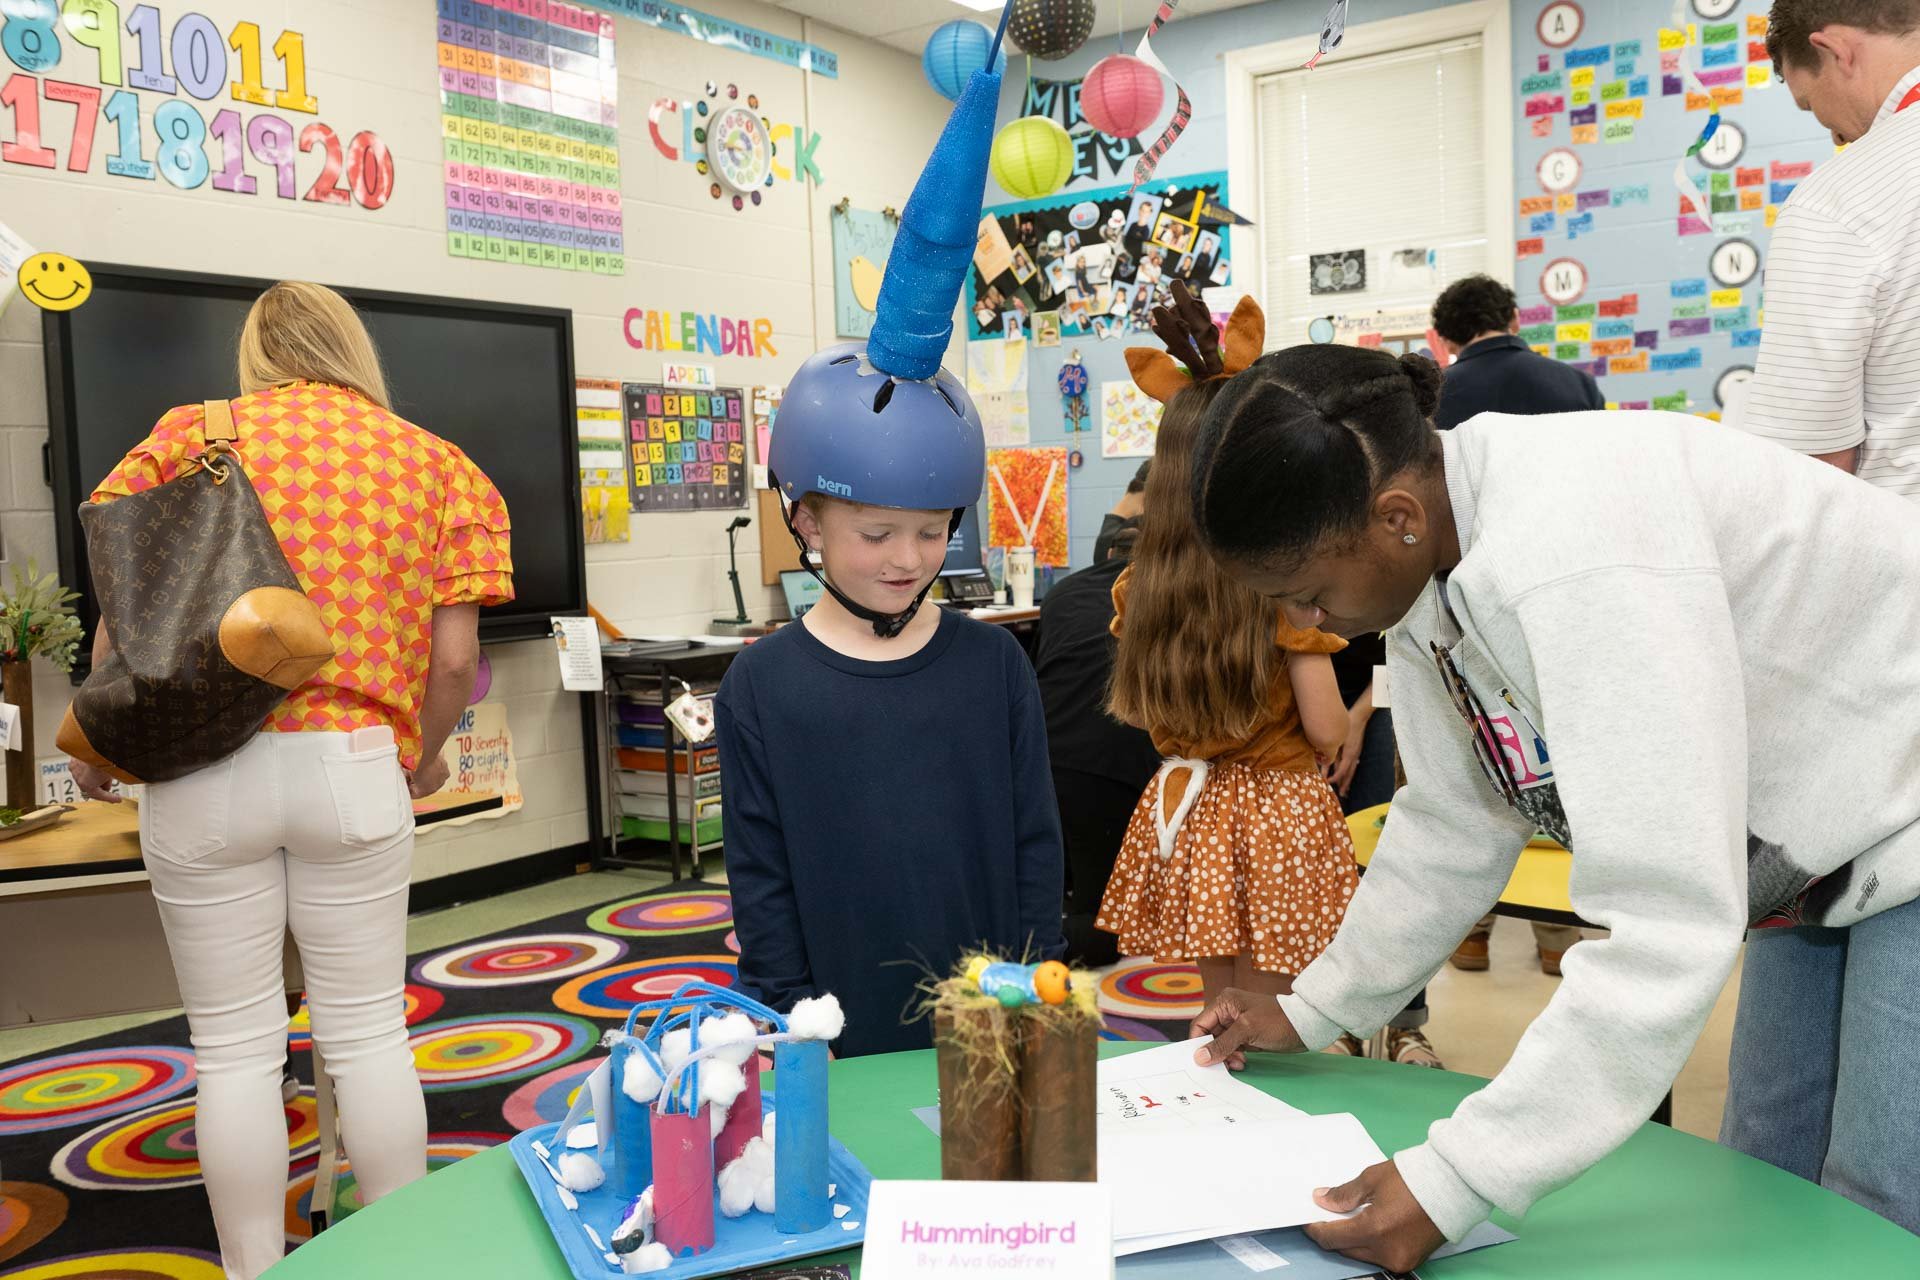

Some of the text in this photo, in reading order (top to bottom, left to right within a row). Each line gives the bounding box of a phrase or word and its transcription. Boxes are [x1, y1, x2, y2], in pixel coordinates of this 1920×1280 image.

[1554, 12, 1566, 34] A
[461, 28, 473, 42] 22
[480, 33, 491, 47] 23
[0, 0, 318, 115] 8 9 10 11
[444, 48, 453, 61] 31
[463, 52, 474, 66] 32
[480, 56, 493, 70] 33
[144, 74, 162, 87] ten
[462, 76, 476, 90] 42
[1521, 73, 1562, 93] about
[47, 85, 98, 100] seventeen
[1606, 121, 1634, 138] also
[0, 73, 394, 210] 17 18 19 20
[465, 123, 478, 136] 62
[484, 127, 497, 140] 63
[502, 131, 515, 143] 64
[521, 135, 534, 148] 65
[605, 152, 617, 164] 70
[1715, 132, 1726, 154] H
[449, 144, 601, 180] 71 72 73 74 75 77 78 79
[1552, 159, 1565, 182] G
[450, 166, 459, 178] 81
[467, 170, 480, 182] 82
[485, 173, 498, 185] 83
[504, 176, 516, 188] 84
[523, 179, 535, 191] 85
[606, 193, 619, 205] 90
[450, 191, 621, 227] 91 92 93 94 95 96 97 98 99 100
[450, 213, 463, 226] 101
[468, 216, 483, 230] 102
[485, 218, 502, 232] 103
[504, 221, 520, 234] 104
[524, 224, 539, 237] 105
[1729, 253, 1741, 274] N
[1555, 270, 1571, 293] M
[1712, 292, 1741, 304] new
[1714, 308, 1749, 330] next
[623, 307, 778, 358] CALENDAR
[1651, 348, 1701, 373] myself
[668, 366, 711, 385] APRIL
[668, 398, 674, 410] 2
[716, 400, 722, 411] 5
[636, 421, 740, 438] 7 8 9 10 11 12 13
[635, 444, 743, 459] 14 15 16 17 18 19 20
[637, 465, 727, 481] 21 22 23 24 25 26
[817, 474, 852, 496] bern
[990, 459, 1060, 546] V
[456, 728, 509, 754] 70 Seventy
[458, 749, 509, 773] 80 eighty
[48, 780, 74, 798] 1 2
[458, 771, 475, 788] 90
[901, 1220, 1076, 1250] Hummingbird
[916, 1253, 1057, 1271] By: Ava Godfrey
